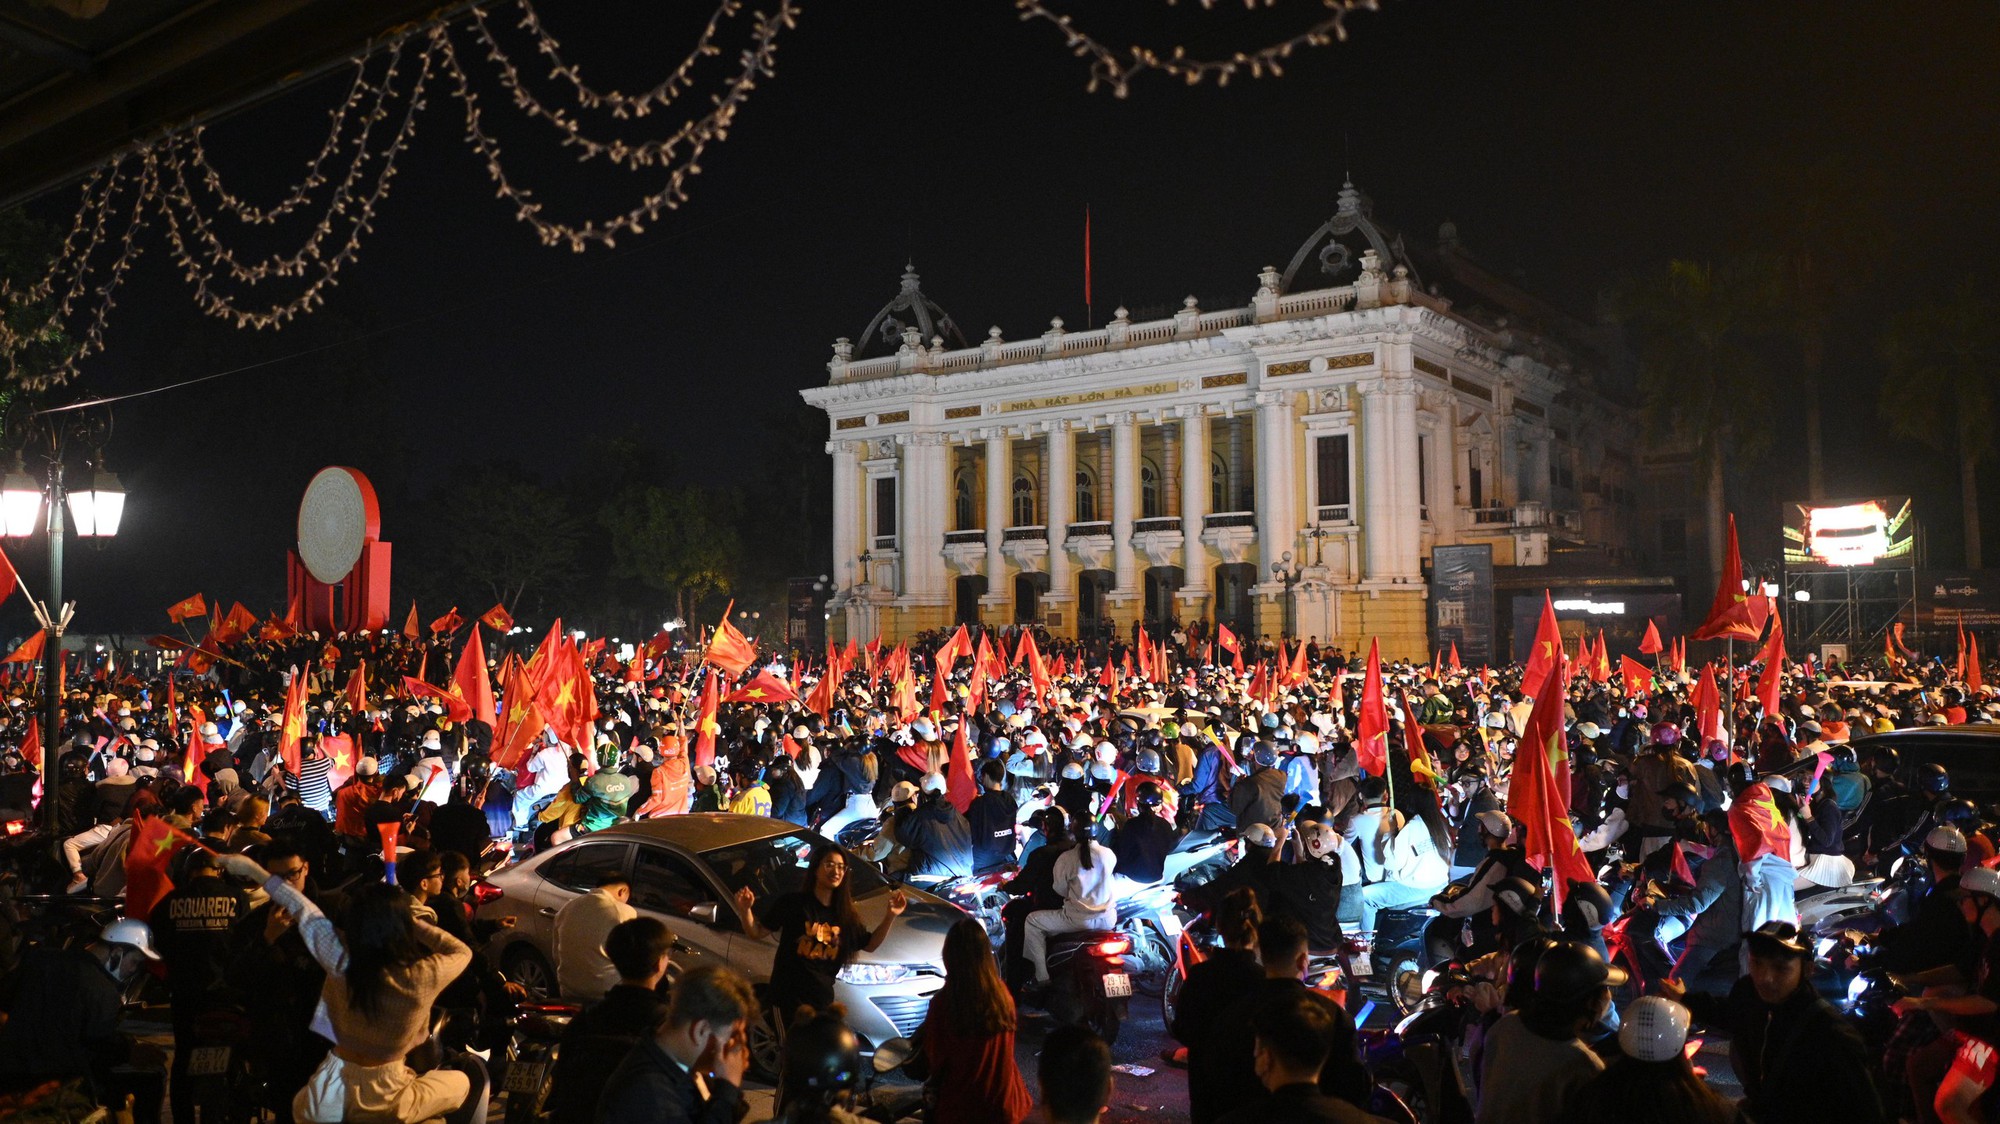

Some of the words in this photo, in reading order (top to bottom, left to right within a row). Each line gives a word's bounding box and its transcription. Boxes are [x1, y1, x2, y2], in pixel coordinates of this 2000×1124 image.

[1011, 399, 1036, 411] NHÀ
[1045, 395, 1070, 406] HÁT
[1078, 391, 1105, 402] LỚN
[1114, 387, 1133, 397] HÀ
[1143, 383, 1167, 394] NỘI
[606, 782, 625, 793] Grab
[170, 897, 237, 919] DSQUARED2
[1107, 985, 1131, 996] 162.19
